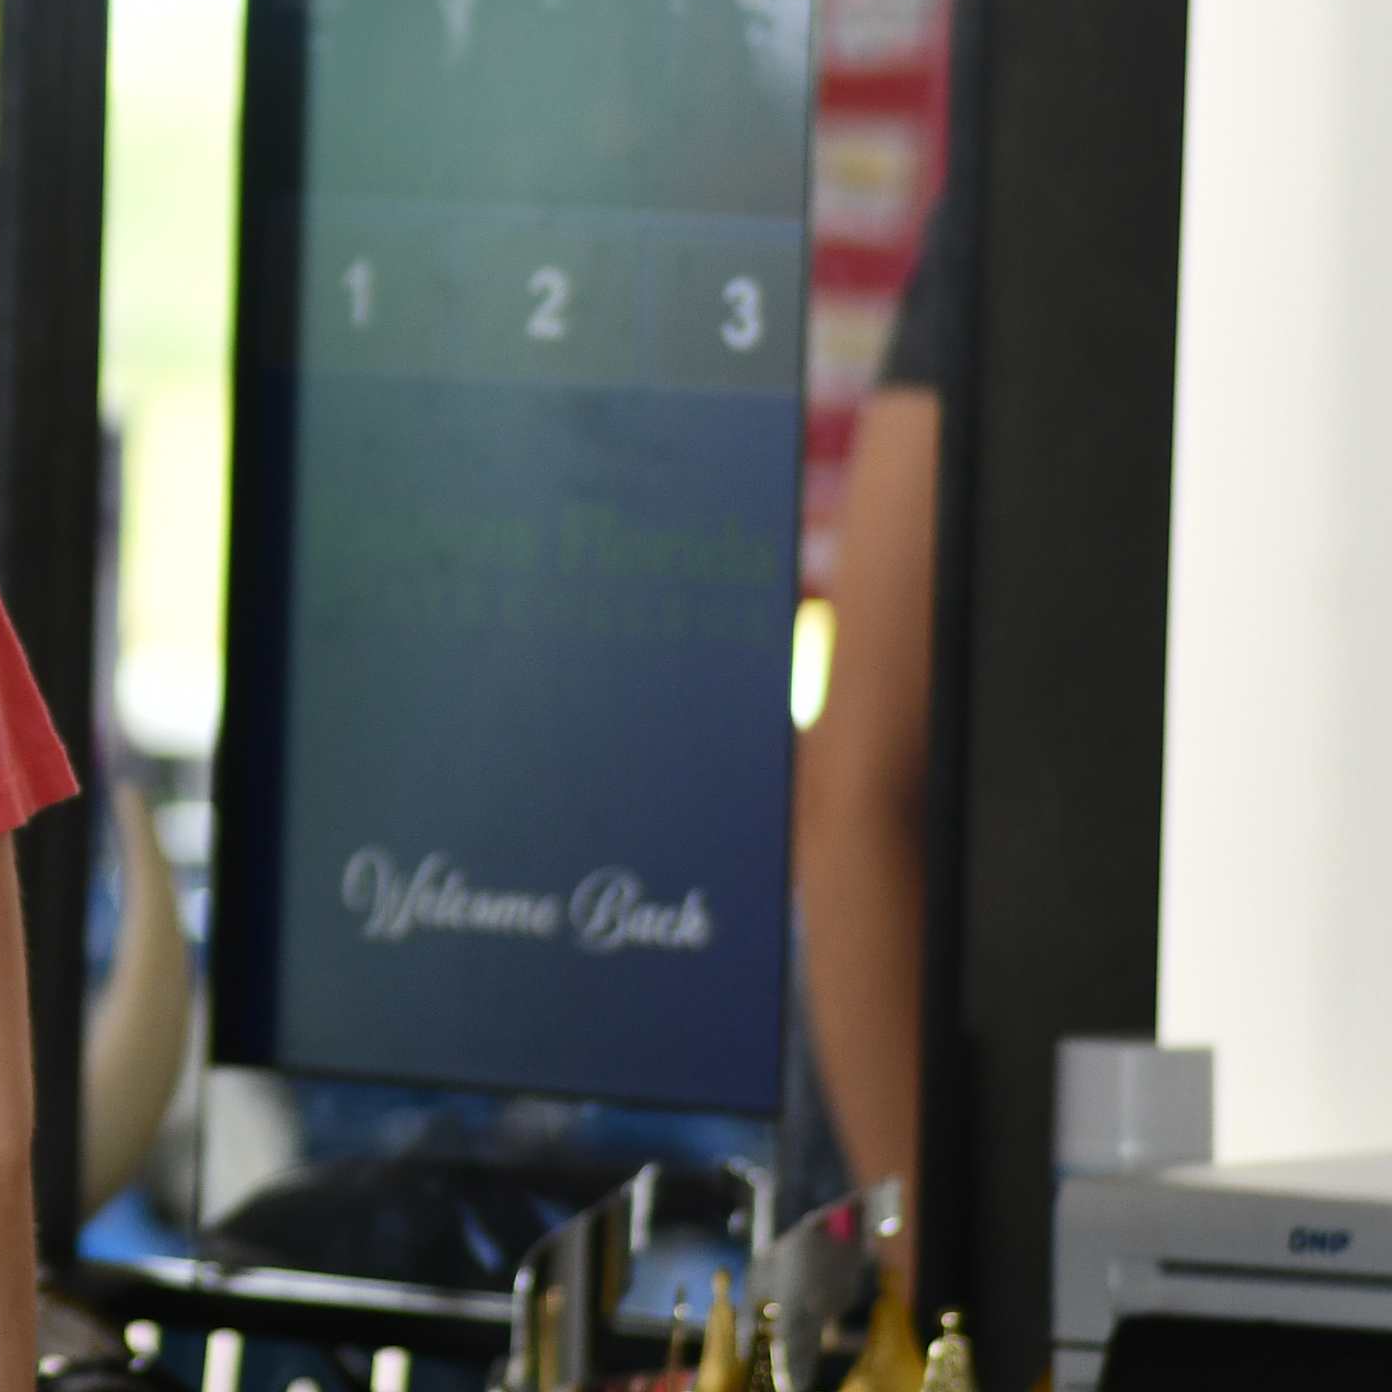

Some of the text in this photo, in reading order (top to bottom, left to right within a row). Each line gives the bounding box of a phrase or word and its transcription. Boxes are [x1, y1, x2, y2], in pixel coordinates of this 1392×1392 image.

[340, 258, 763, 351] 1 2 3
